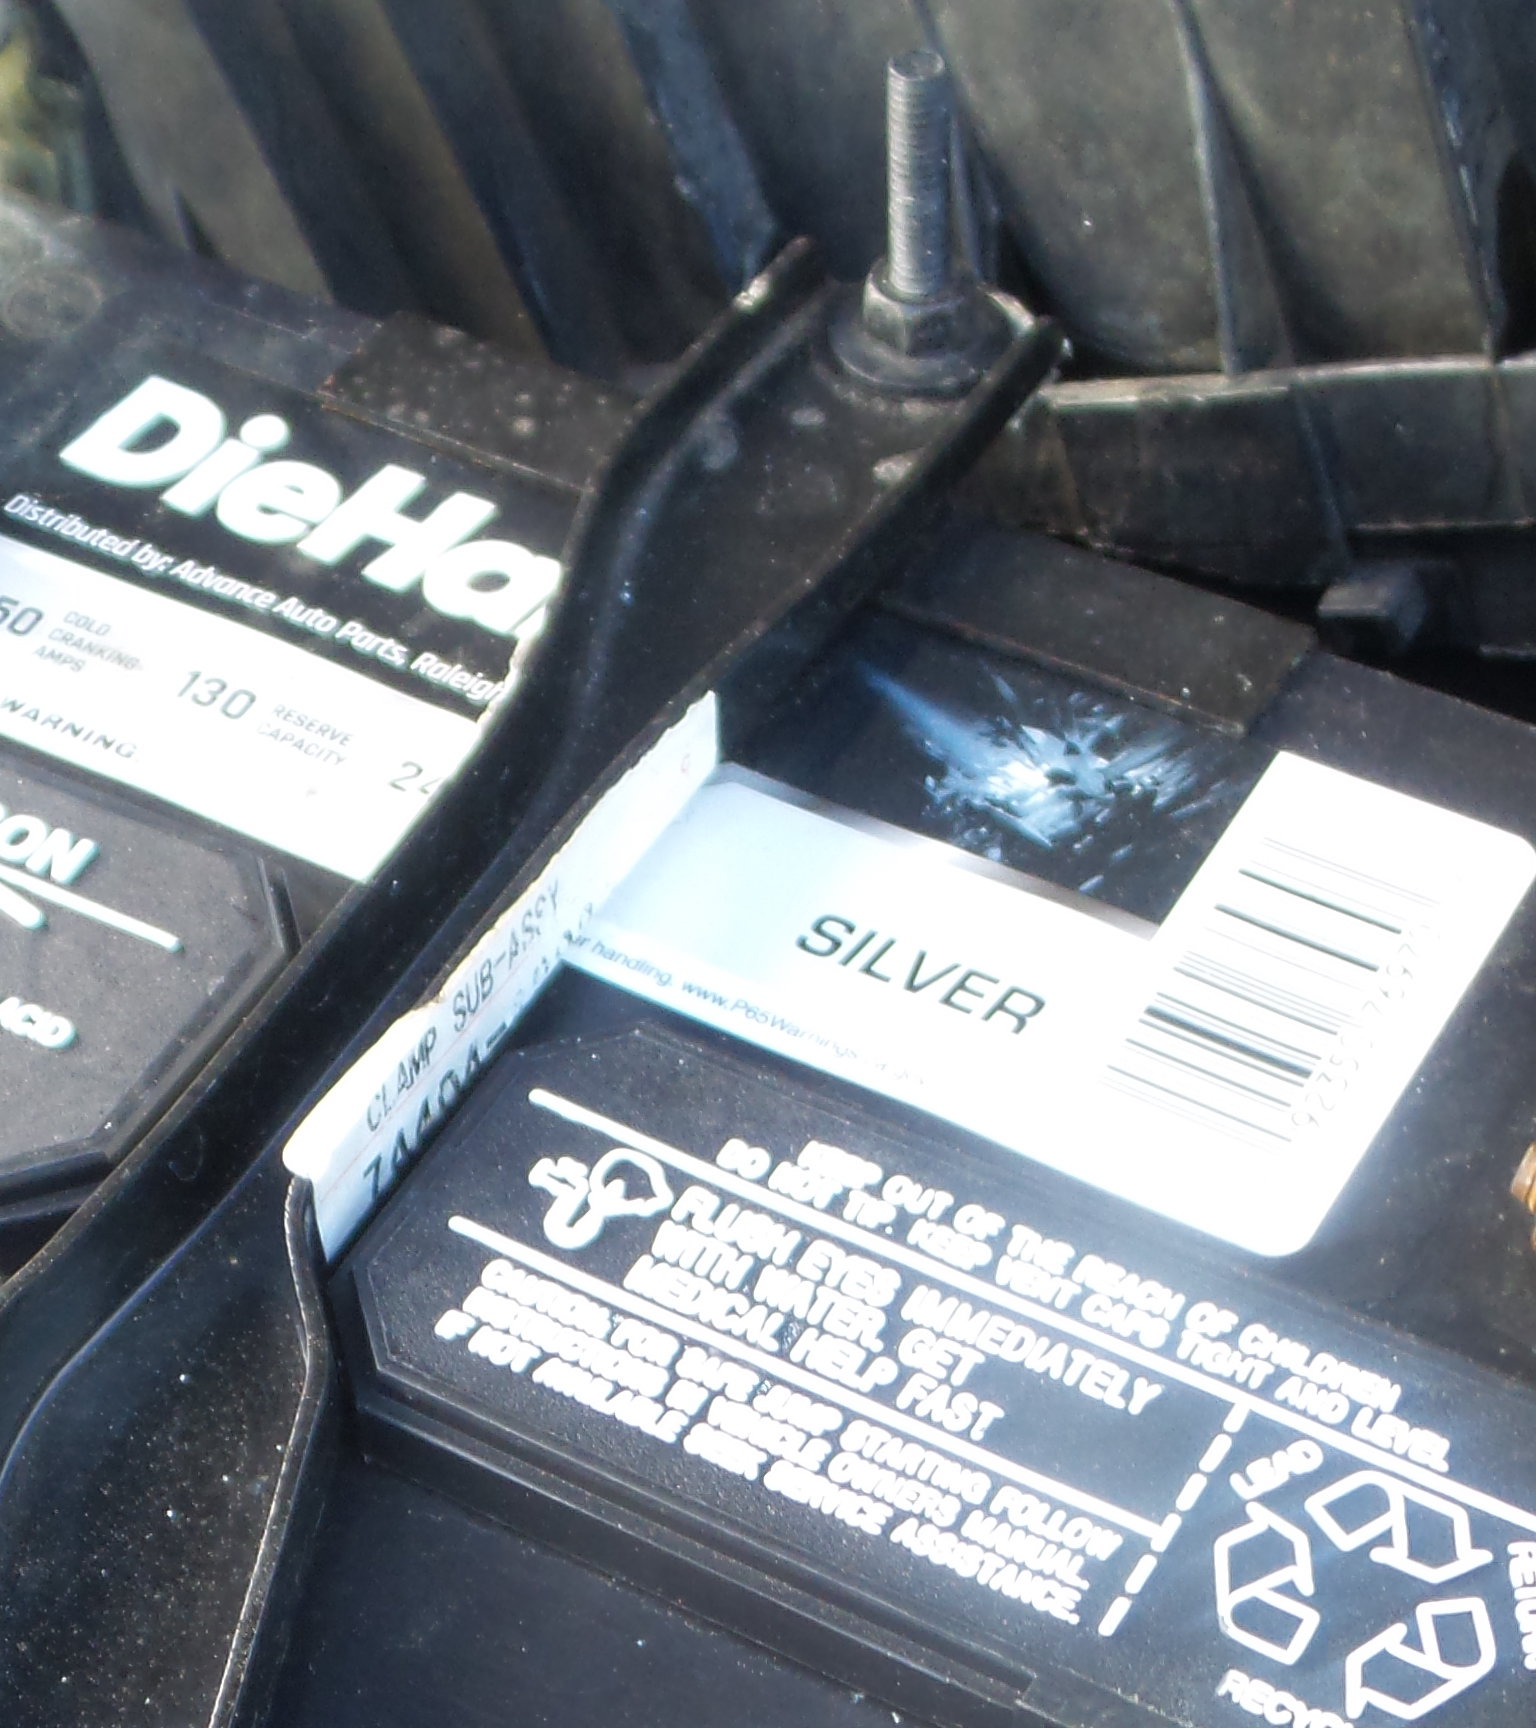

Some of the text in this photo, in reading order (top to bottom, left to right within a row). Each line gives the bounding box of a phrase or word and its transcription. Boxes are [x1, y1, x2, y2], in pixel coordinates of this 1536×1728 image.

[59, 374, 567, 640] DieHa
[4, 495, 140, 558] Distributed
[131, 543, 174, 577] by:
[169, 561, 275, 611] Advance
[273, 597, 337, 635] Auto
[335, 621, 408, 666] Parts,
[62, 610, 112, 637] COLD
[32, 645, 86, 674] AMPS
[47, 627, 140, 671] CRANKING
[177, 669, 257, 722] 130
[0, 697, 138, 759] WARNING
[258, 724, 348, 767] CAPACITY
[272, 703, 354, 747] RESERVE
[795, 913, 1047, 1035] SILVER
[366, 1026, 438, 1132] CLAMP
[468, 1326, 541, 1372] NOT
[624, 1255, 1004, 1441] MEDICAL HELP FAST
[652, 1220, 753, 1289] WITH
[898, 1328, 985, 1386] GET
[671, 1186, 1164, 1417] FLUSH EYES IMMEDIATELY
[717, 1139, 770, 1179] DO
[768, 1162, 847, 1209] NOT
[907, 1219, 992, 1270] KEEP
[996, 1254, 1082, 1309] VENT
[1082, 1287, 1170, 1348] CAPS
[1177, 1328, 1274, 1389] TIGHT
[1275, 1376, 1349, 1424] AND
[1351, 1406, 1450, 1472] LEVEL
[880, 1175, 953, 1220] OUT
[954, 1205, 1005, 1248] OF
[1007, 1225, 1075, 1275] THE
[1072, 1255, 1185, 1321] REACH
[1185, 1302, 1238, 1346] OF
[1239, 1324, 1401, 1412] CHILDREN
[611, 1317, 679, 1371] FOR
[676, 1346, 759, 1402] SAFE
[753, 1380, 843, 1436] JUMP
[840, 1420, 991, 1504] STARTING
[990, 1486, 1123, 1560] FOLLOW
